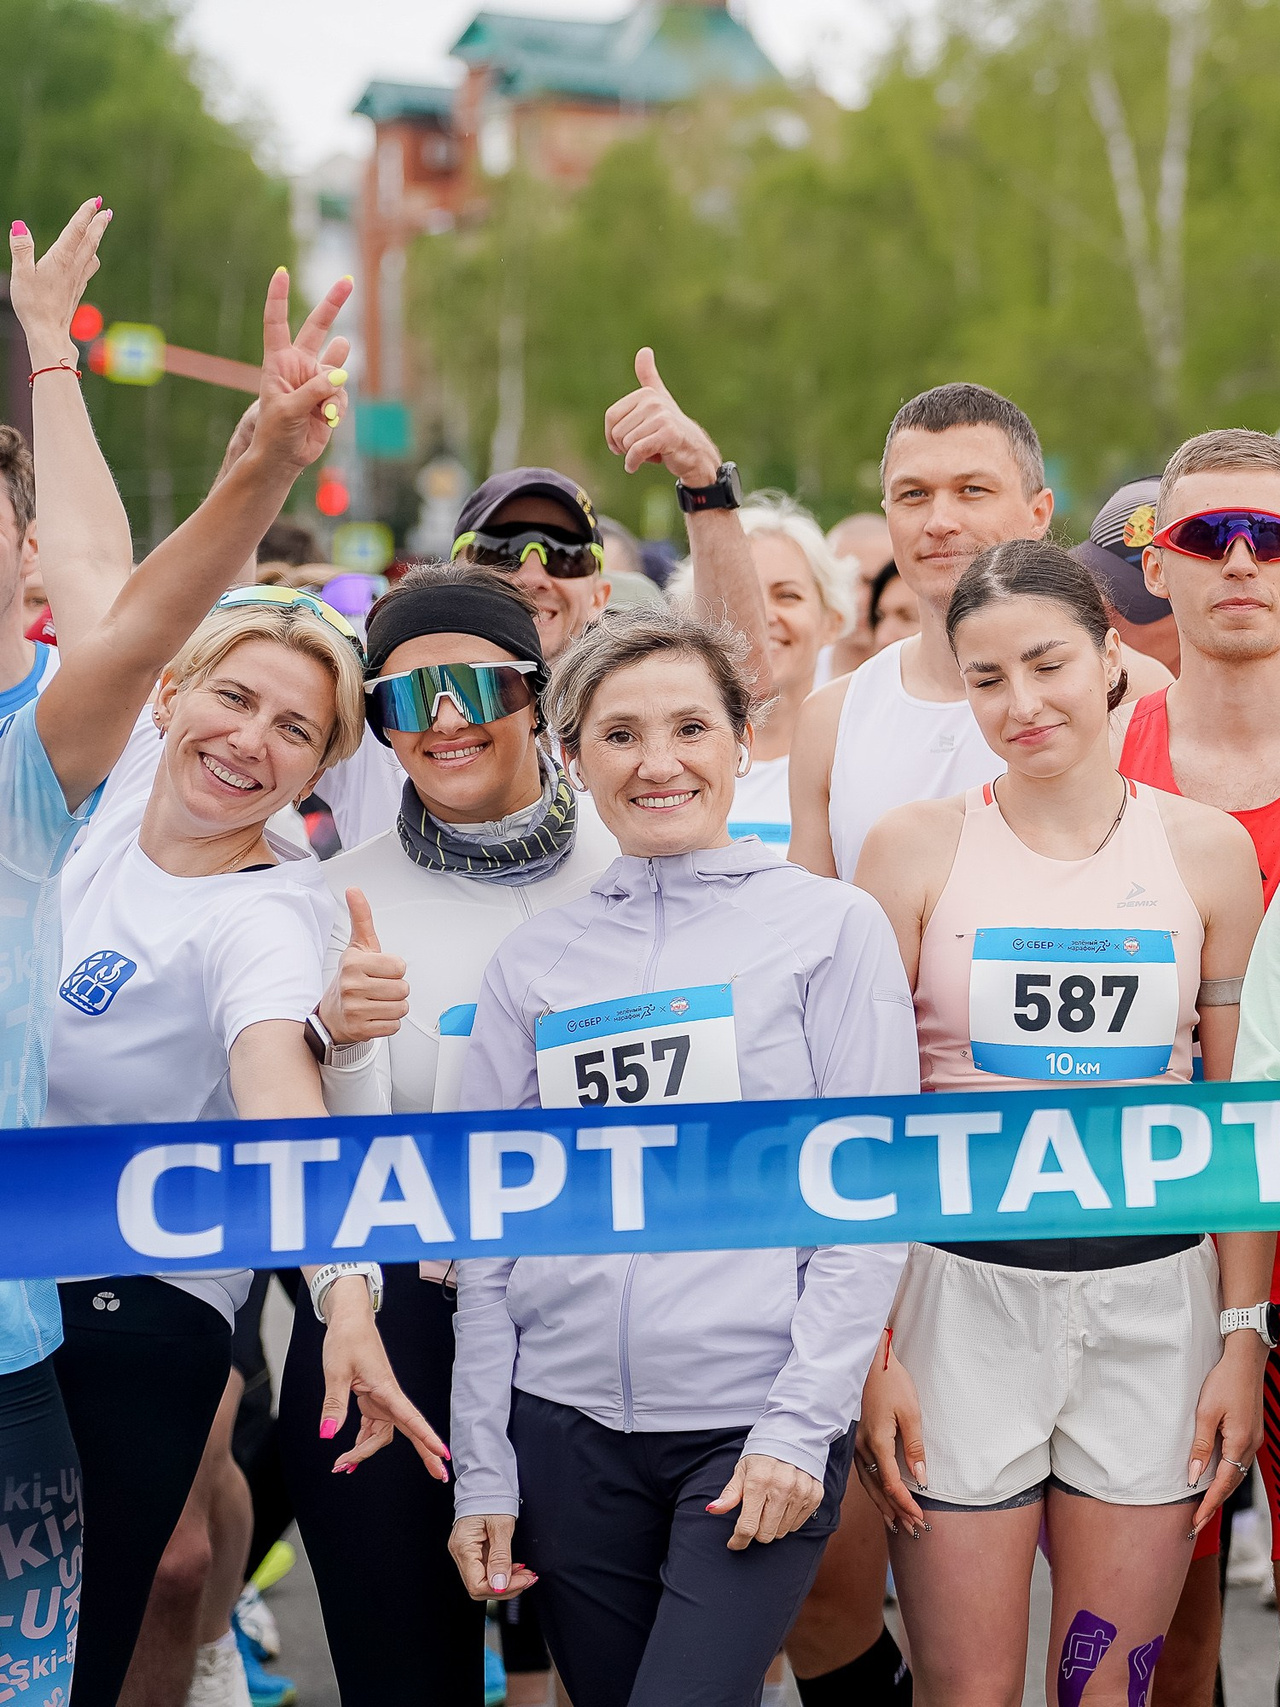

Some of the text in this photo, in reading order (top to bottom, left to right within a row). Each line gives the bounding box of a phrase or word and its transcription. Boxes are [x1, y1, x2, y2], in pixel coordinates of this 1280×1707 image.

[1116, 900, 1158, 909] DEMIX
[1026, 941, 1054, 949] СБЕР
[1013, 973, 1140, 1033] 587
[578, 1016, 602, 1028] СБЕР
[574, 1034, 691, 1108] 557
[116, 1123, 677, 1259] СТАРТ
